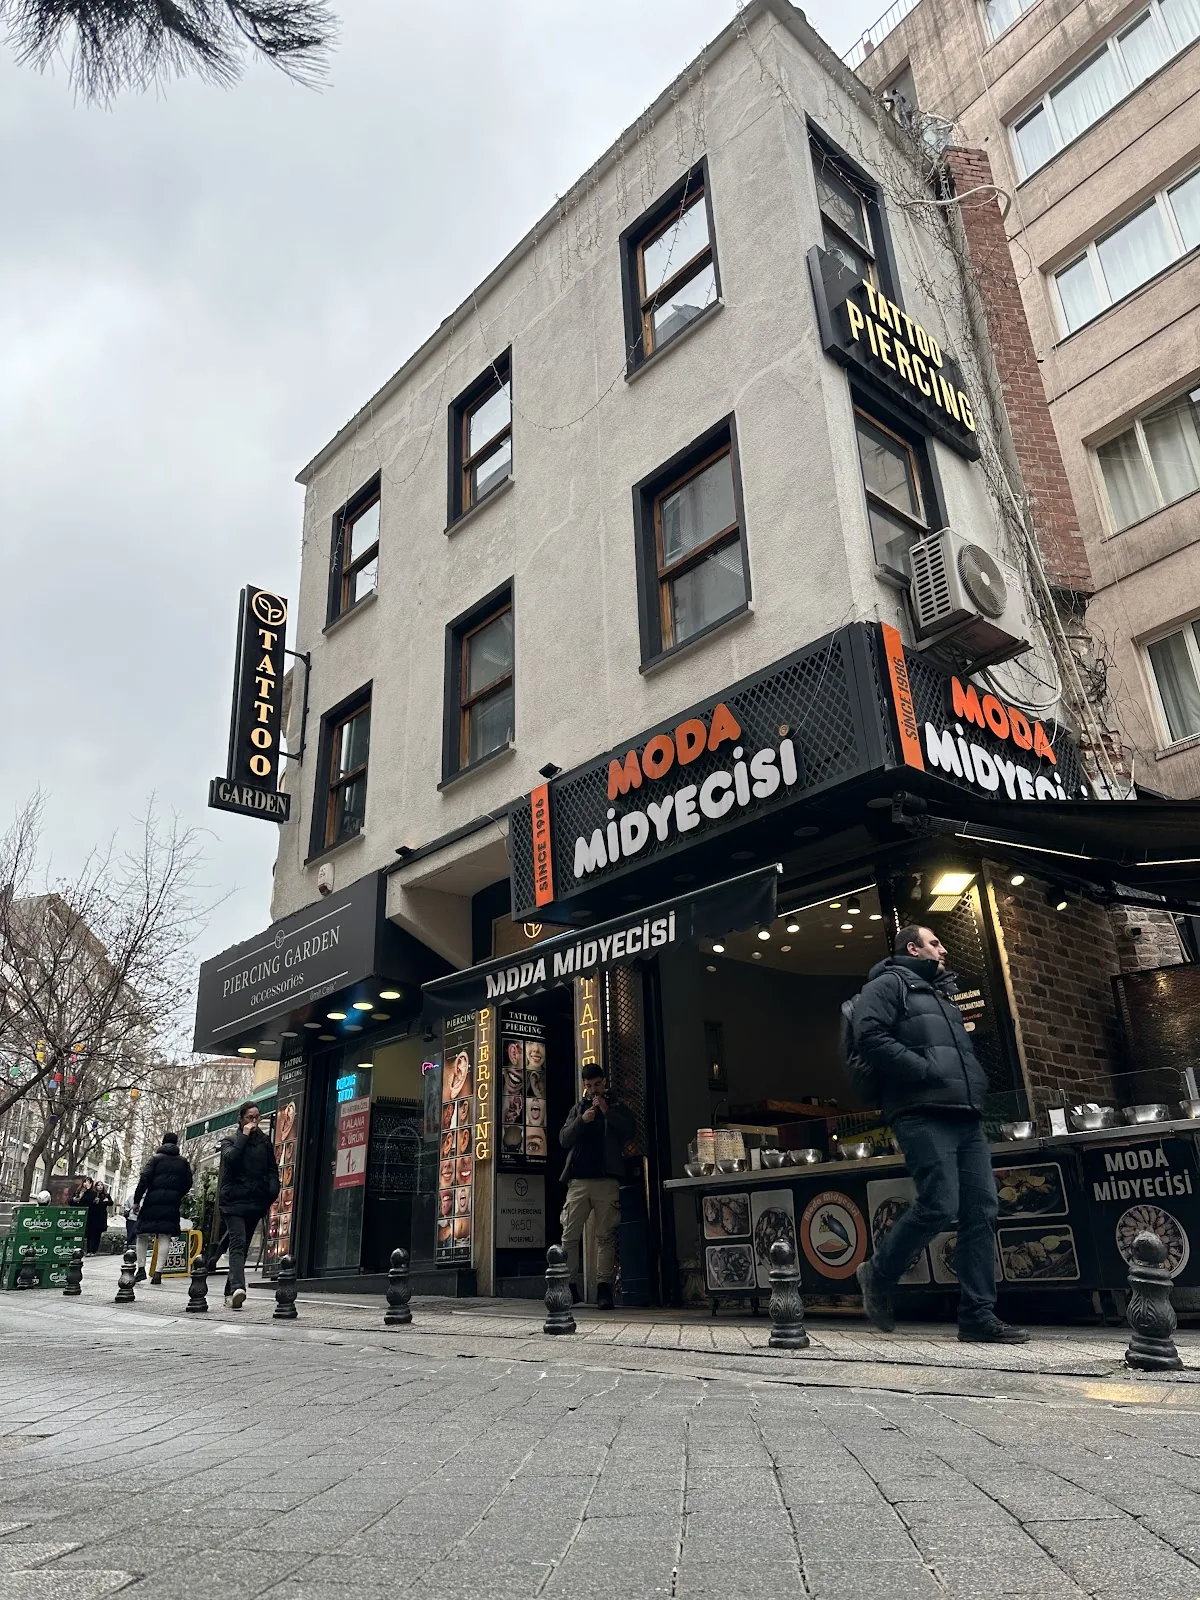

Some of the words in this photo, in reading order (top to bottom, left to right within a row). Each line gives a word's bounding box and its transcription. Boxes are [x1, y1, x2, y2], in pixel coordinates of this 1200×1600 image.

[862, 278, 943, 368] TATTOO
[846, 298, 976, 432] PIERCING
[893, 657, 909, 694] 1986
[250, 628, 277, 776] TATTOO
[951, 675, 1057, 765] MODA
[607, 703, 742, 800] MODA
[218, 782, 287, 815] GARDEN
[573, 738, 798, 879] MİDYECİSİ
[536, 797, 547, 838] 1986
[222, 955, 280, 998] PIERCING
[284, 925, 340, 968] GARDEN
[485, 962, 546, 999] MODA
[553, 910, 677, 977] MİDYECİSİ
[250, 972, 304, 1006] accessories
[446, 1012, 476, 1029] PIERCING
[505, 1022, 542, 1035] PIERCING
[508, 1011, 538, 1022] TATTOO
[281, 1068, 303, 1082] PIERCING
[283, 1055, 303, 1069] TATTOO
[474, 1007, 491, 1160] PIERCING
[346, 1116, 365, 1129] ALANA
[1103, 1148, 1170, 1172] MODA
[1093, 1168, 1193, 1202] MİDYECİSİ
[22, 1217, 52, 1230] Carlsberg
[57, 1218, 84, 1229] Carlsberg
